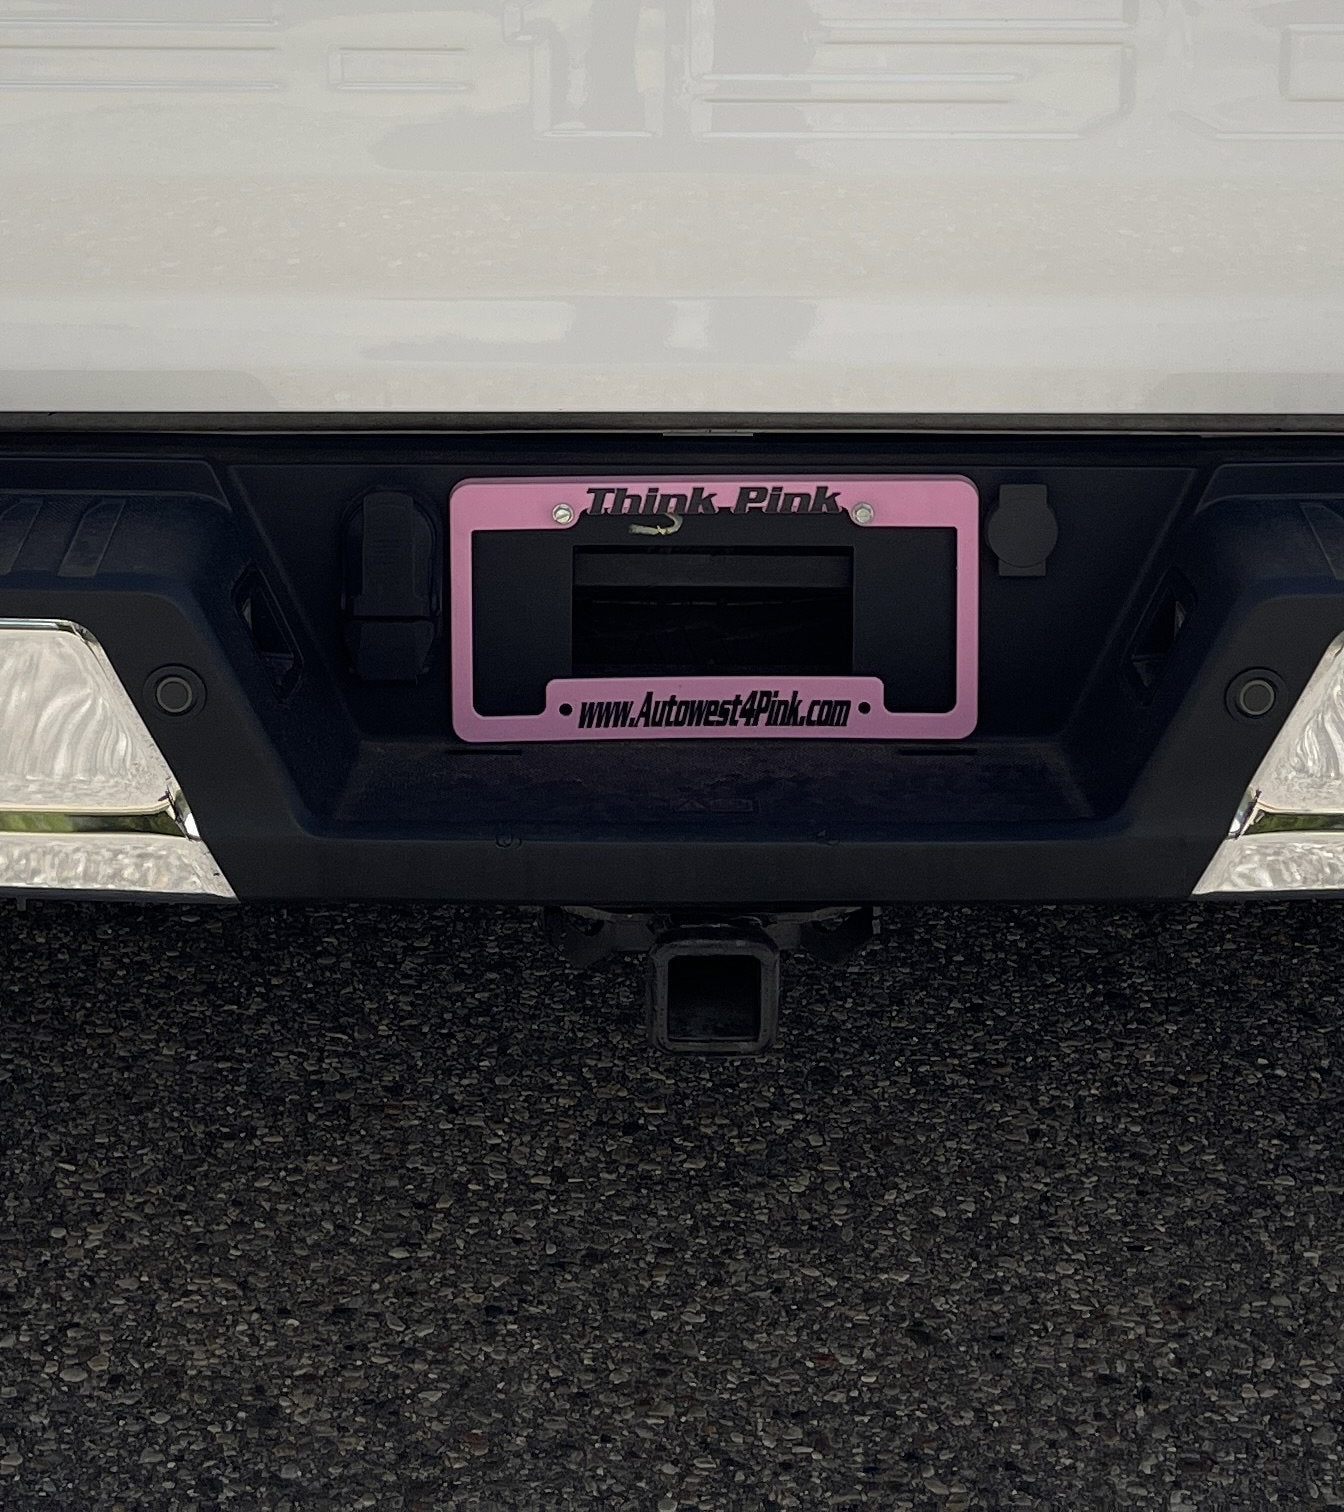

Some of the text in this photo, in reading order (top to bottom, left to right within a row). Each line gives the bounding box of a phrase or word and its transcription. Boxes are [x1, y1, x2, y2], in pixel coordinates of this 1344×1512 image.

[586, 485, 843, 516] Think Pink
[577, 690, 852, 729] www.Autowest4Pink.com
